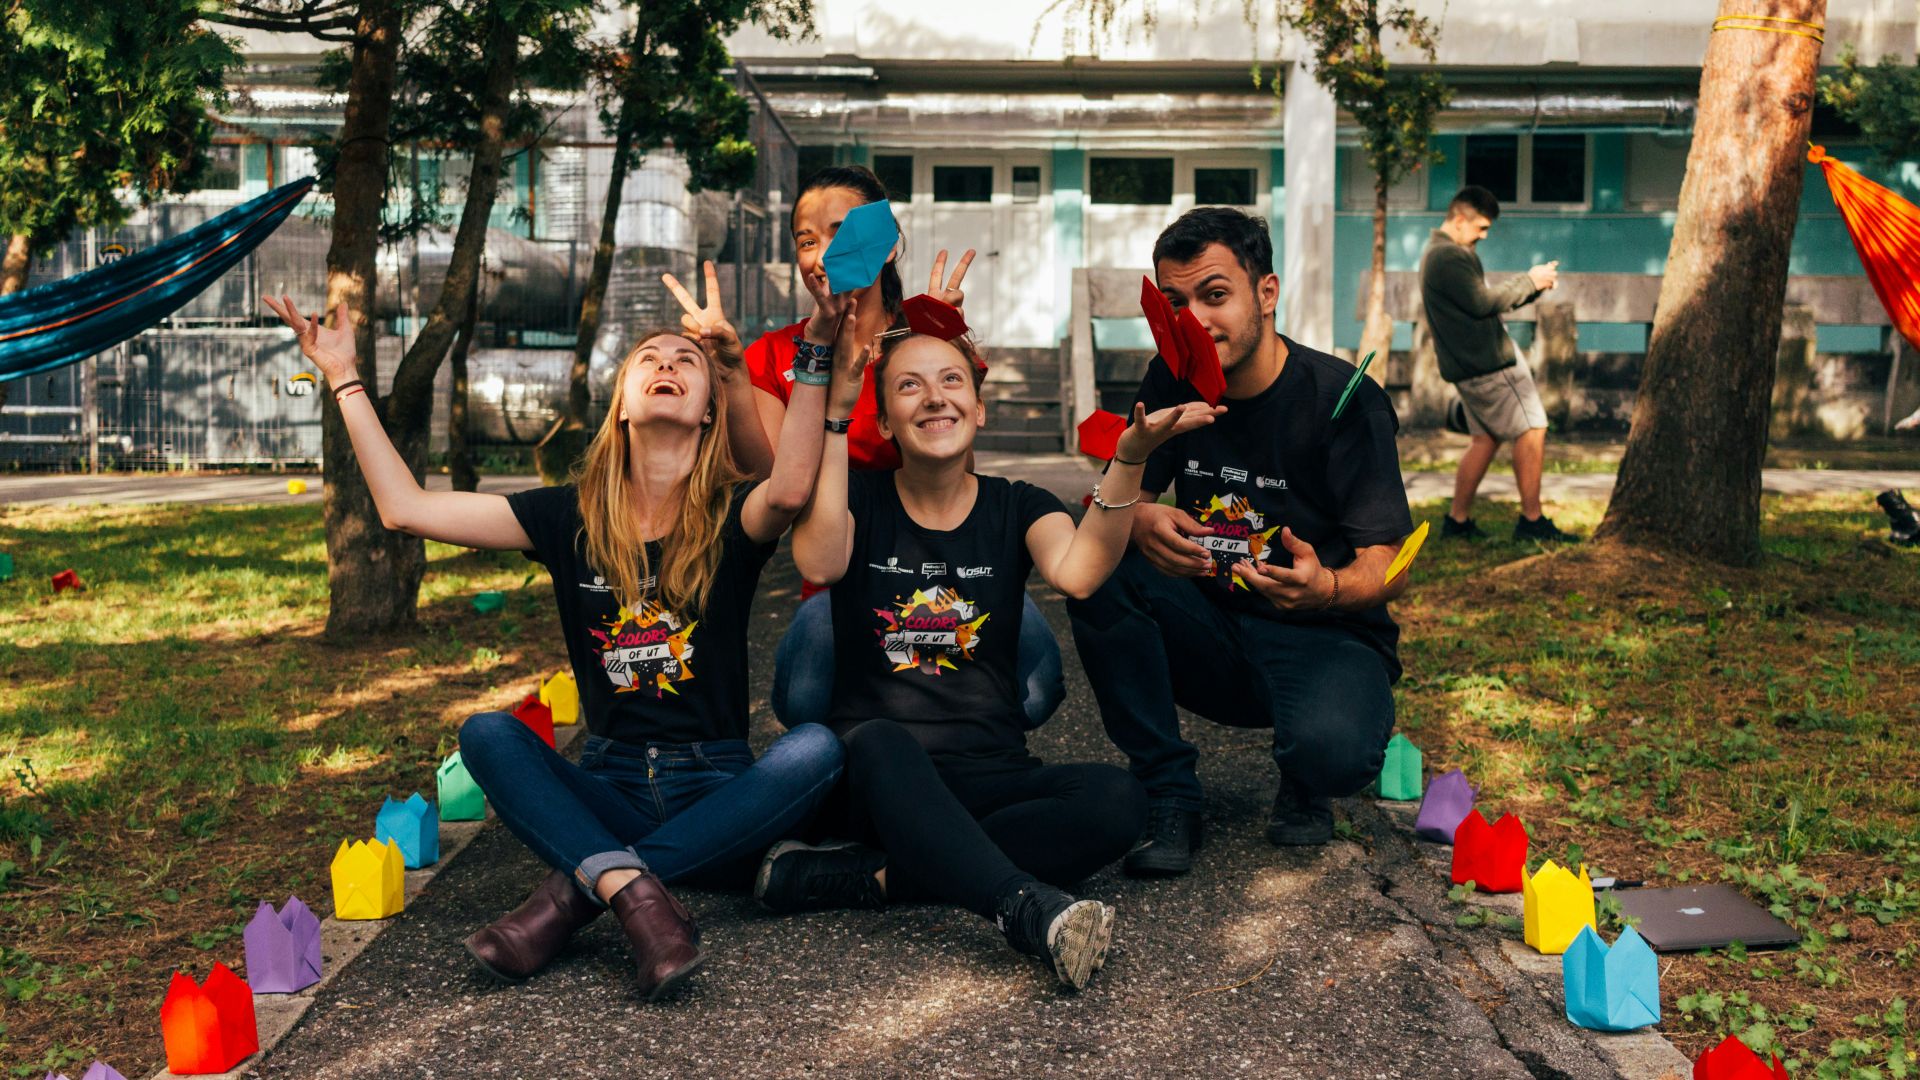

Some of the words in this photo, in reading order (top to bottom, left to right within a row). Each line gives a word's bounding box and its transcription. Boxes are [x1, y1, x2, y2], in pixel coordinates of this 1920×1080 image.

[286, 380, 313, 396] VTS
[1211, 539, 1224, 549] OF
[1227, 541, 1240, 551] UT
[904, 616, 958, 630] COLORS
[616, 628, 668, 647] COLORS
[914, 634, 928, 643] OF
[932, 634, 947, 643] UT
[628, 650, 642, 660] OF
[646, 647, 660, 658] UT
